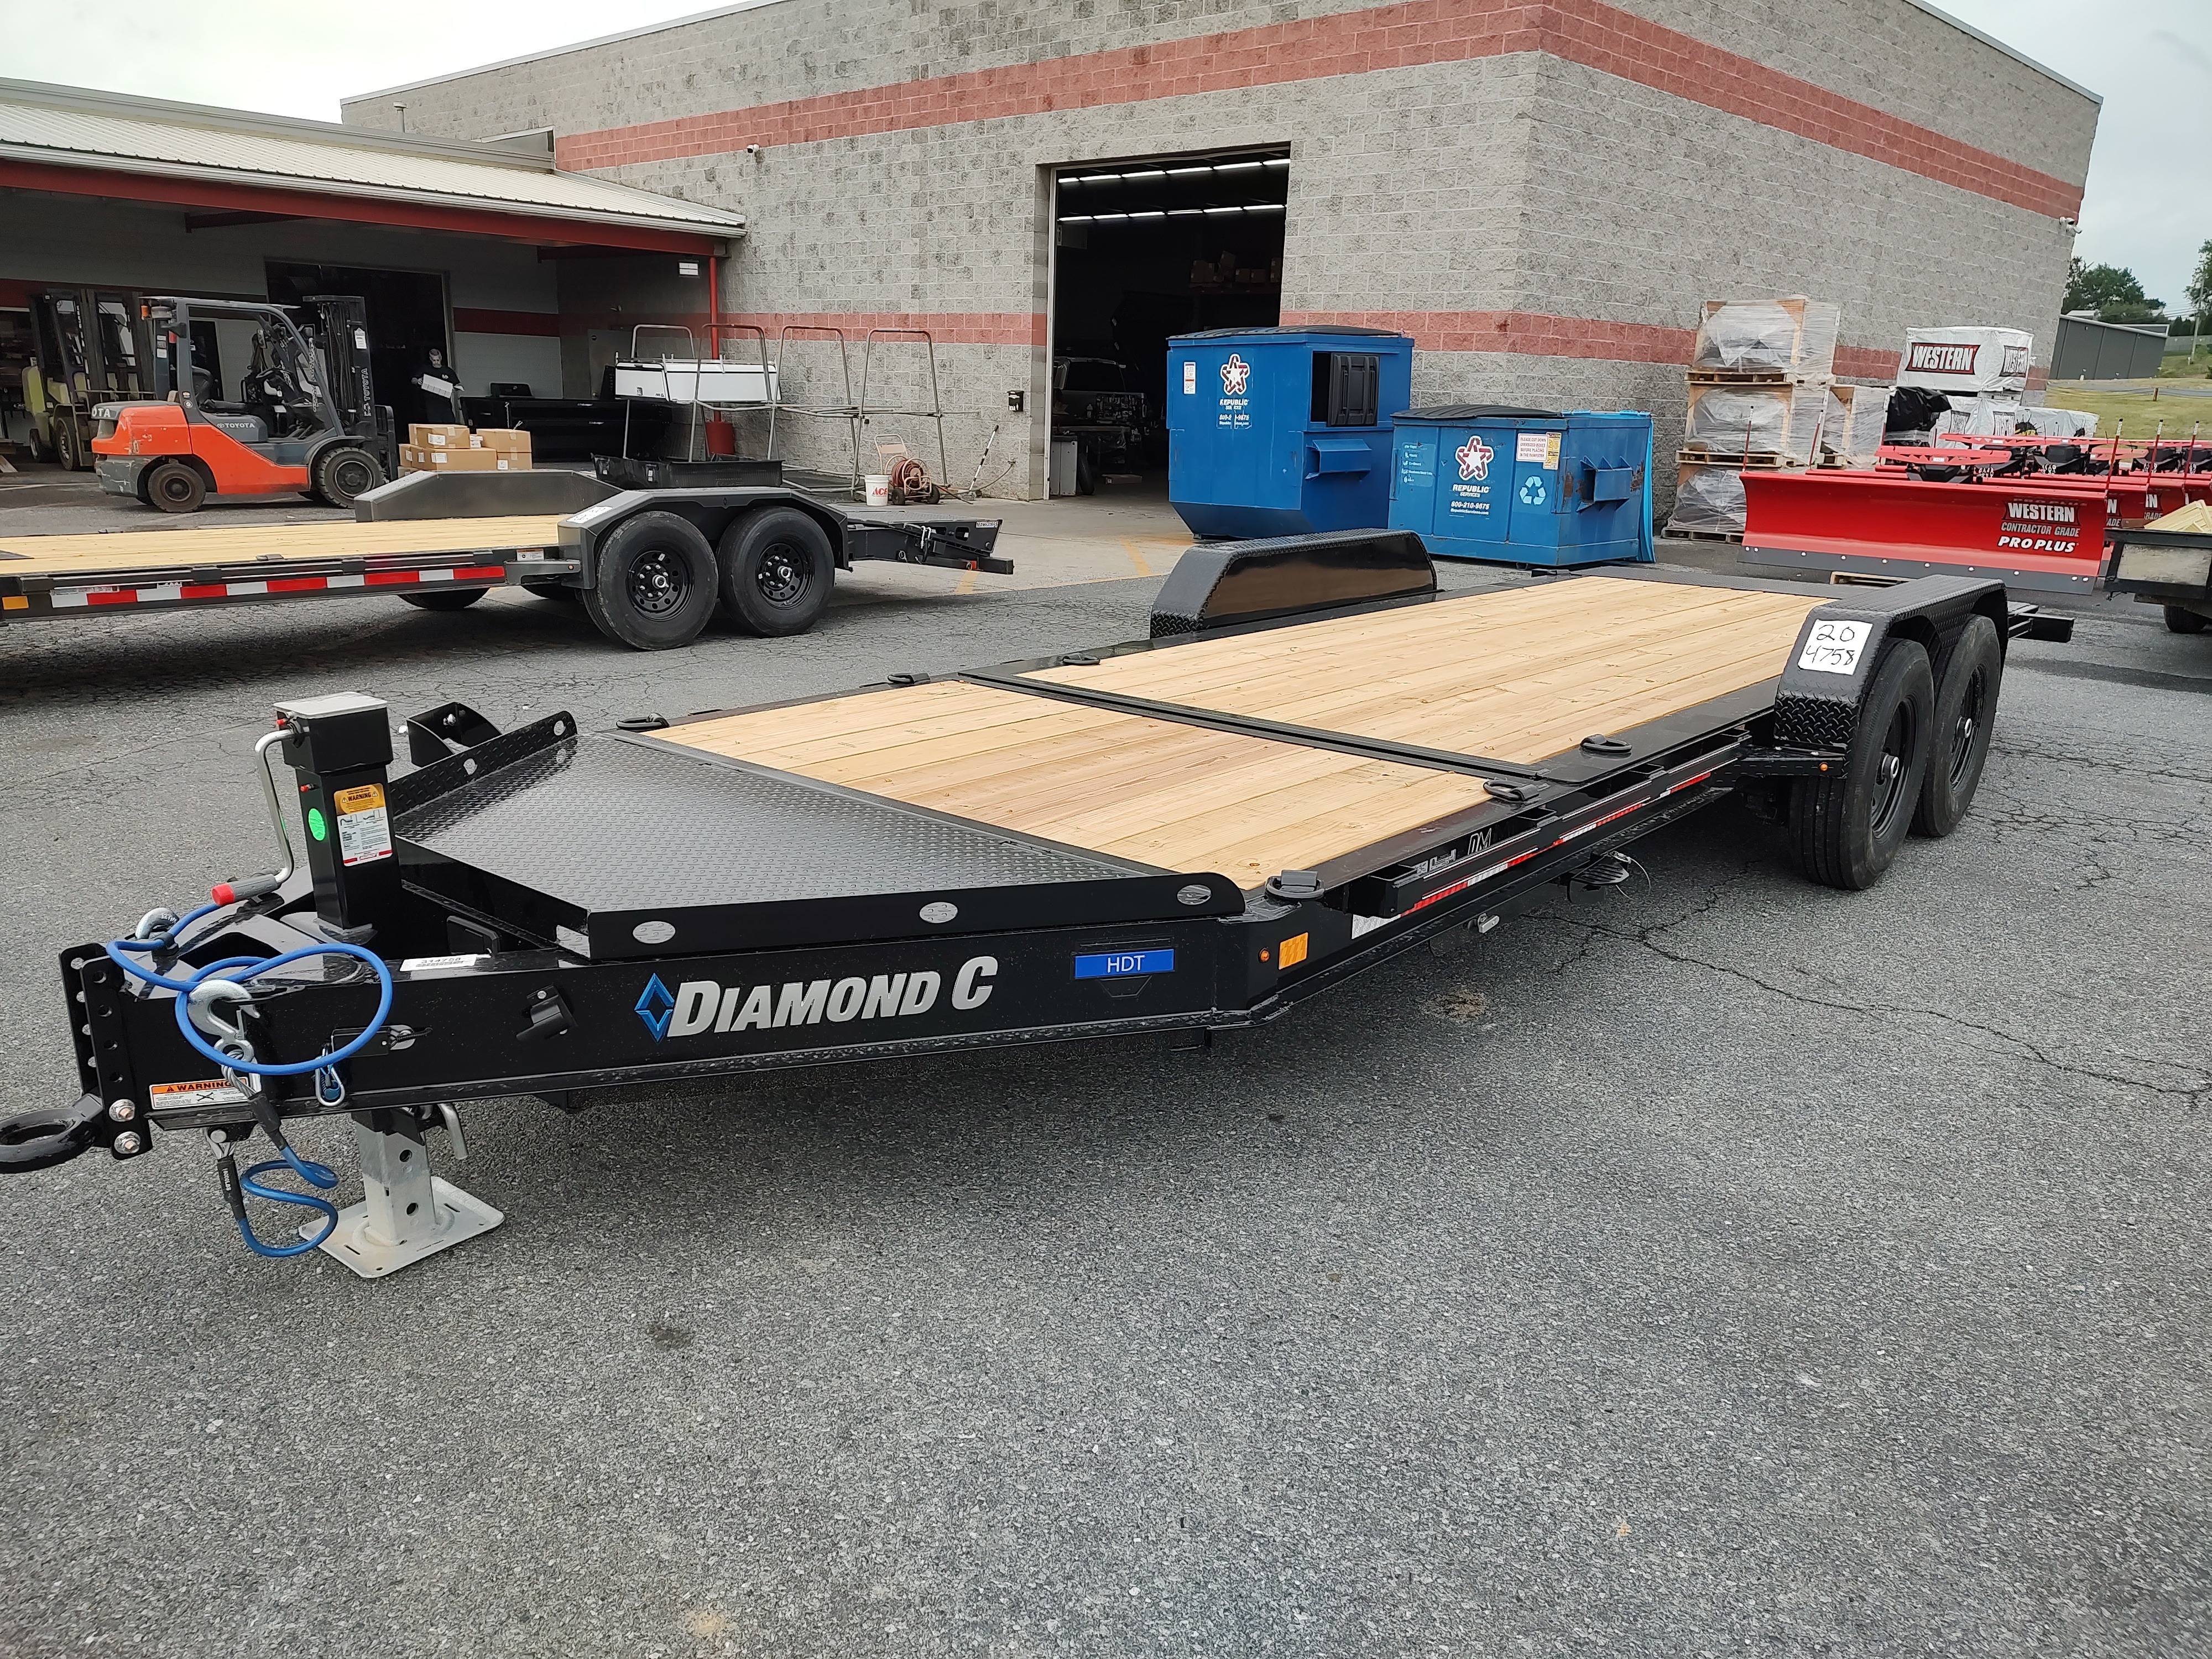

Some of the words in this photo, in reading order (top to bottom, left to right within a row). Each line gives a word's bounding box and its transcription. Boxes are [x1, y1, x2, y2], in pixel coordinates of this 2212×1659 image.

[1912, 346, 1974, 371] WESTERN
[361, 368, 371, 401] TOYOTA
[92, 408, 110, 417] OTA
[1453, 484, 1489, 493] REPUBLIC
[2008, 503, 2074, 522] WESTERN
[2001, 522, 2052, 535] CONTRACTOR
[2054, 526, 2081, 537] GRADE
[2107, 518, 2121, 526] ADE
[1817, 624, 1855, 641] 20
[1806, 645, 1855, 665] 4758
[347, 792, 372, 801] WARNING
[1108, 955, 1145, 973] HDT
[667, 971, 941, 1037] DIAMOND
[951, 956, 998, 1010] C
[177, 1081, 232, 1091] WARNING
